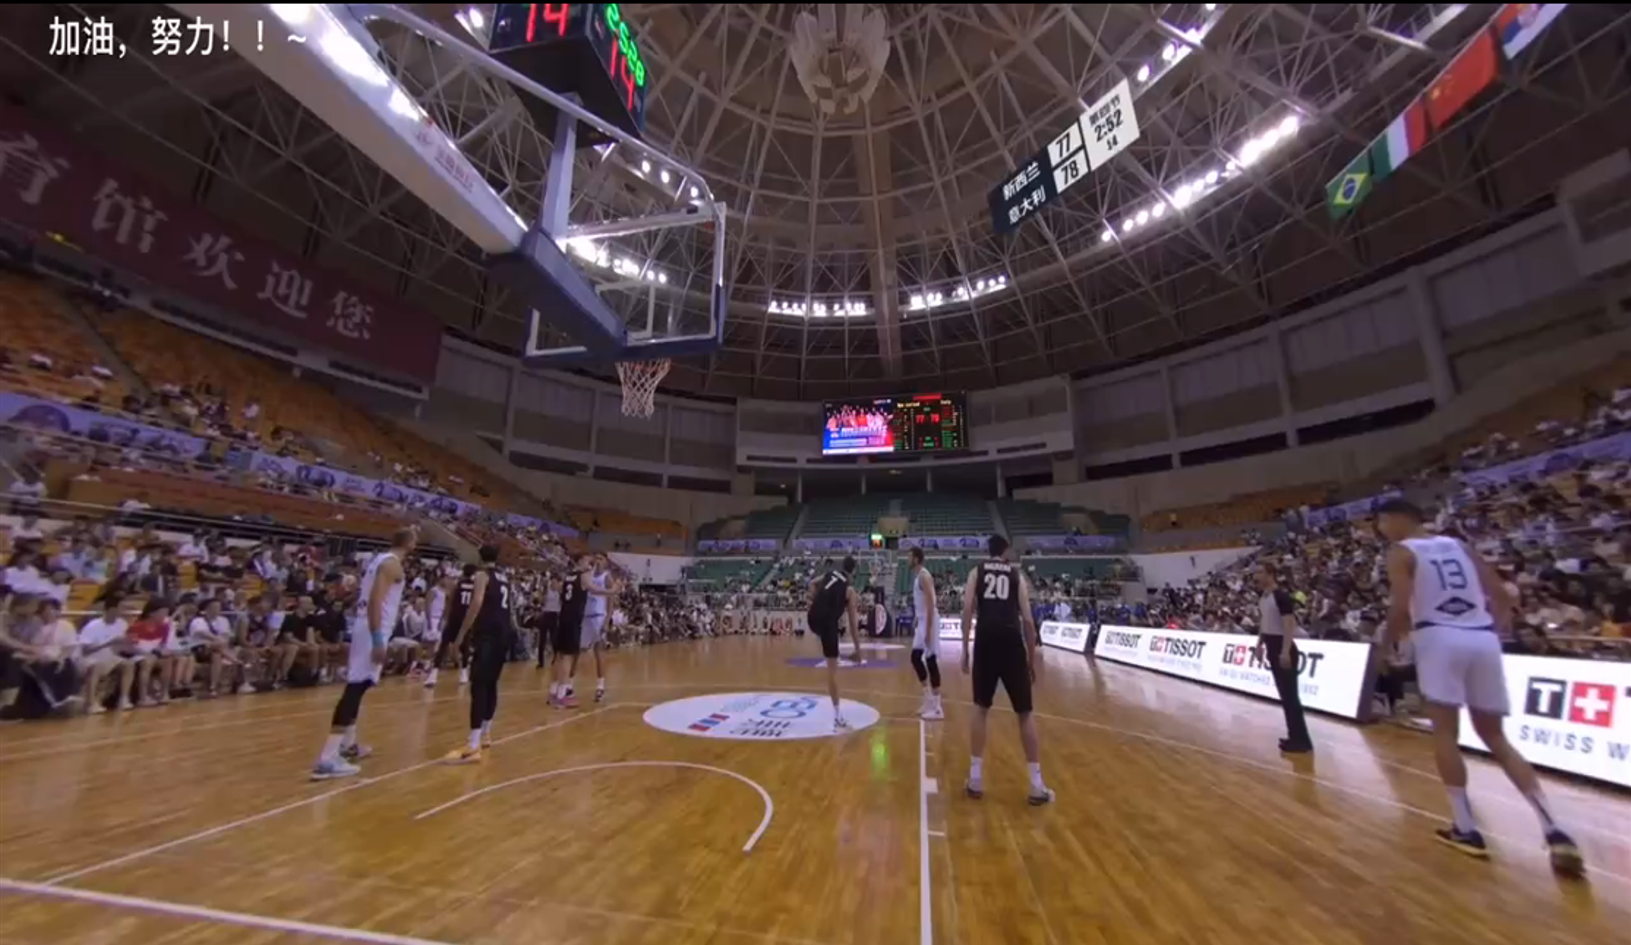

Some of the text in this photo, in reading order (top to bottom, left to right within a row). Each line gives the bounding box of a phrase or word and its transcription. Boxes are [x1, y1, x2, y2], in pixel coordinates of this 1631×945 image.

[1094, 108, 1124, 142] 2:52
[1056, 132, 1071, 158] 77
[1106, 134, 1119, 151] 14
[1003, 161, 1041, 200] 新西兰
[1061, 160, 1079, 185] 78
[1008, 185, 1047, 225] 意大利
[984, 573, 1010, 600] 20
[1429, 559, 1467, 591] 13
[460, 591, 472, 605] 11
[1163, 637, 1207, 659] TISSOT
[1520, 724, 1594, 754] SWISS
